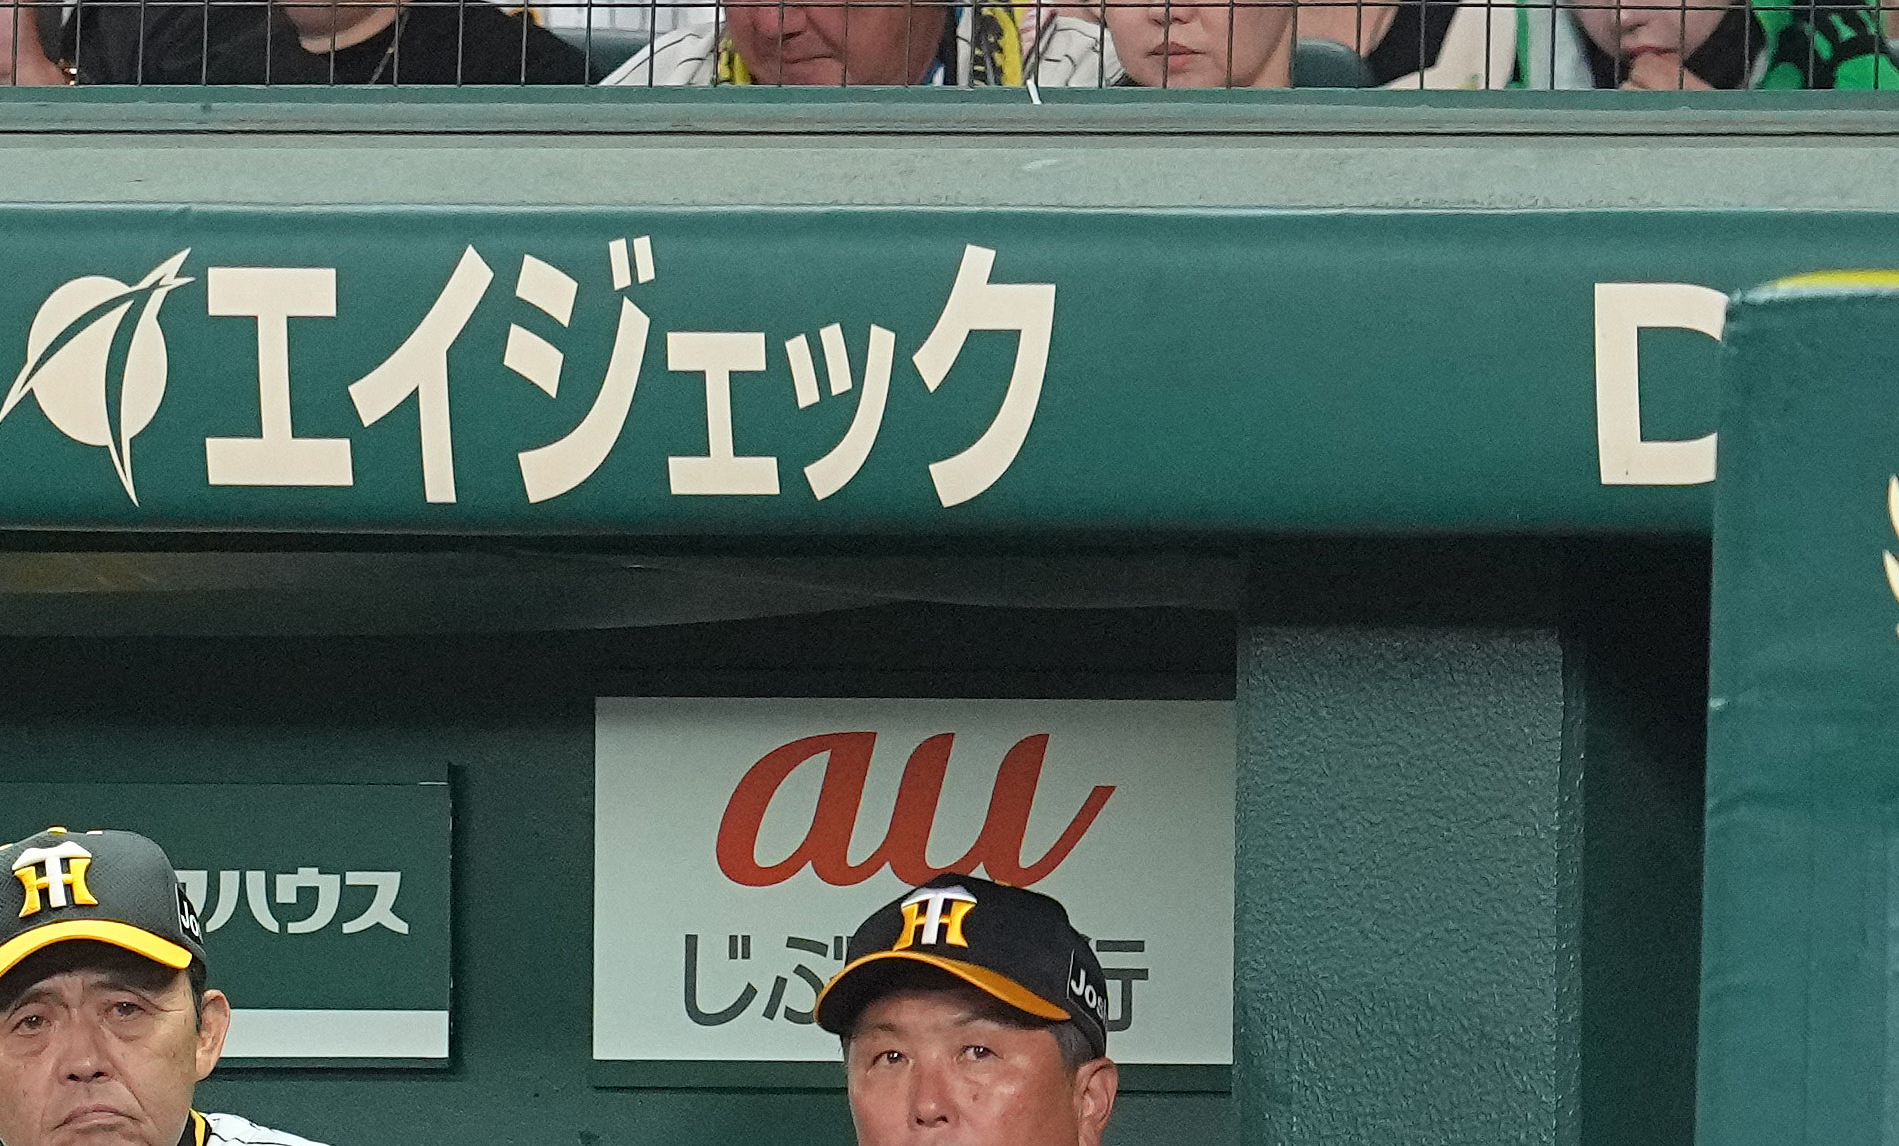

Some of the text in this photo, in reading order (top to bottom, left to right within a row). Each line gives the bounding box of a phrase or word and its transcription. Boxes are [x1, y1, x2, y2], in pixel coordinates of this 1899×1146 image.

[205, 235, 1057, 507] エイジェック
[716, 731, 1116, 888] au
